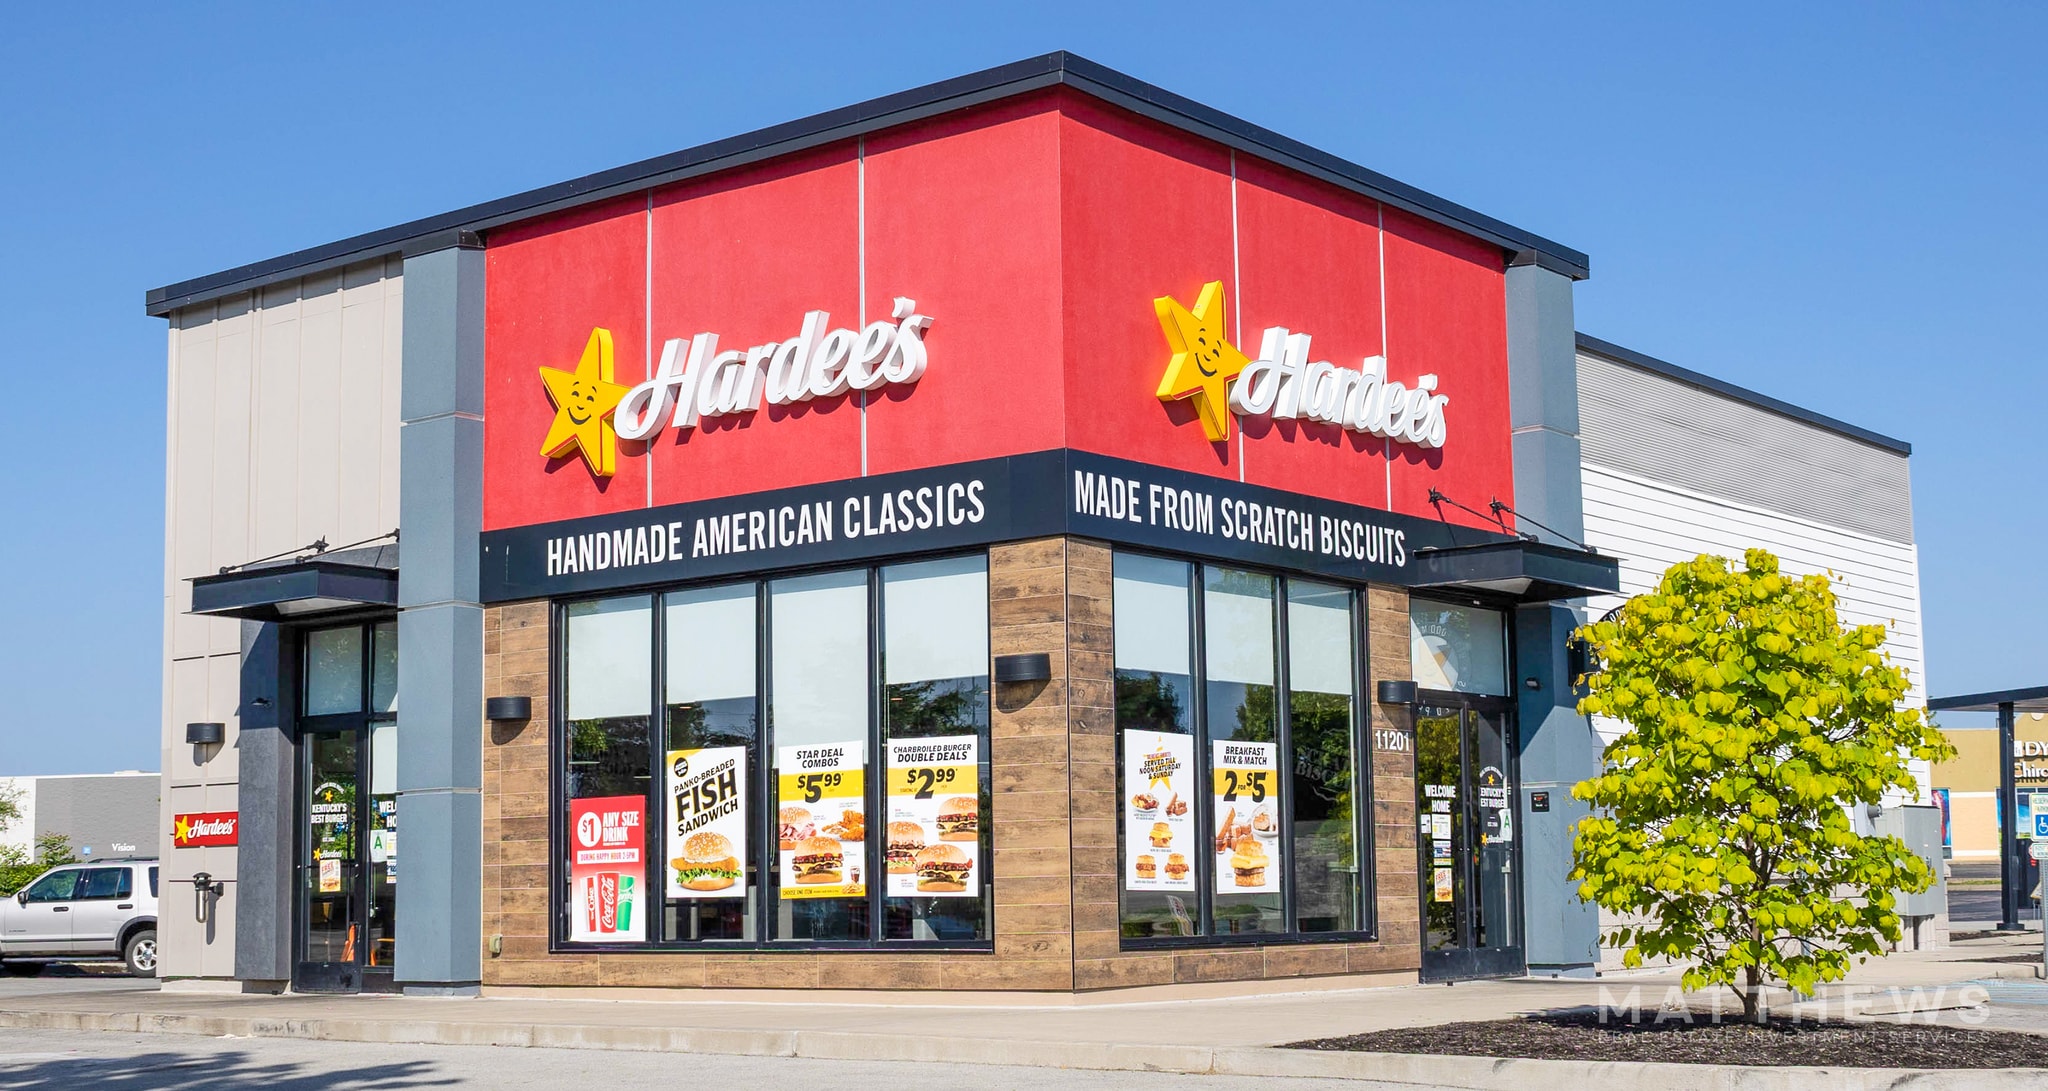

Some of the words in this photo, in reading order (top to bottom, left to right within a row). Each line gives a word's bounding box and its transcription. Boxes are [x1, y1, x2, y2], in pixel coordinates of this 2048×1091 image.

[614, 297, 933, 440] Hardee's
[1229, 326, 1449, 449] Hardee's
[1075, 470, 1142, 524] MADE
[1149, 484, 1214, 535] FROM
[1220, 498, 1313, 552] SCRATCH
[1320, 516, 1406, 568] BISCUITS
[547, 521, 682, 576] HANDMADE
[692, 501, 833, 558] AMERICAN
[843, 480, 985, 539] CLASSICS
[1375, 730, 1410, 752] 11201
[796, 749, 819, 760] STAR
[821, 748, 844, 758] DEAL
[893, 744, 942, 754] CHARBROILED
[943, 744, 972, 752] BURGER
[1225, 746, 1265, 756] BREAKFAST
[802, 758, 839, 768] COMBOS
[897, 753, 935, 762] DOUBLE
[937, 751, 967, 761] DEALS
[1144, 759, 1164, 767] SERVED
[1223, 756, 1237, 764] MIX
[1244, 757, 1267, 765] MATCH
[1153, 771, 1173, 779] SUNDAY
[1155, 763, 1181, 773] SATURDAY
[674, 759, 735, 793] PANKO-BREADED
[1223, 770, 1238, 801] 2
[1246, 771, 1267, 802] $5
[1425, 784, 1456, 798] WELCOME
[676, 768, 738, 823] FISH
[312, 803, 347, 813] KENTUCKY'S
[1432, 800, 1450, 812] HOME
[311, 814, 324, 824] BEST
[325, 814, 347, 823] BURGER
[603, 812, 620, 827] ANY
[621, 811, 639, 827] SIZE
[678, 799, 739, 836] SANDWICH
[1504, 815, 1510, 828] A
[188, 819, 236, 839] Hardee's
[582, 818, 595, 842] $1
[603, 827, 628, 842] DRINK
[112, 843, 136, 851] Vision
[374, 835, 382, 849] A
